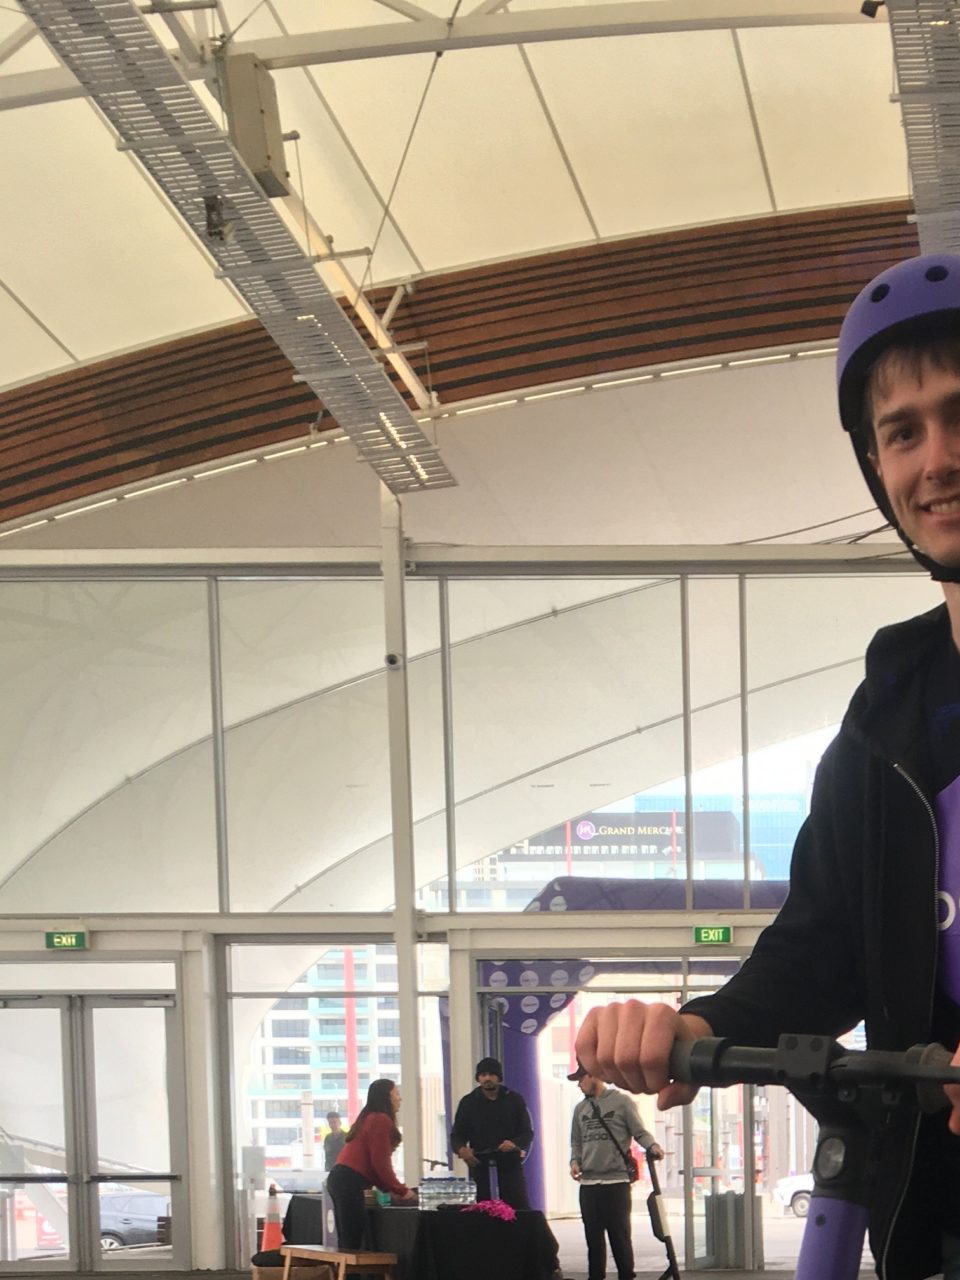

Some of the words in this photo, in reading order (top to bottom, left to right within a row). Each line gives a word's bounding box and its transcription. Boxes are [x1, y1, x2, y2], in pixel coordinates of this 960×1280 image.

[599, 826, 635, 835] GRAND
[54, 934, 77, 946] EXIT
[701, 929, 724, 941] EXIT
